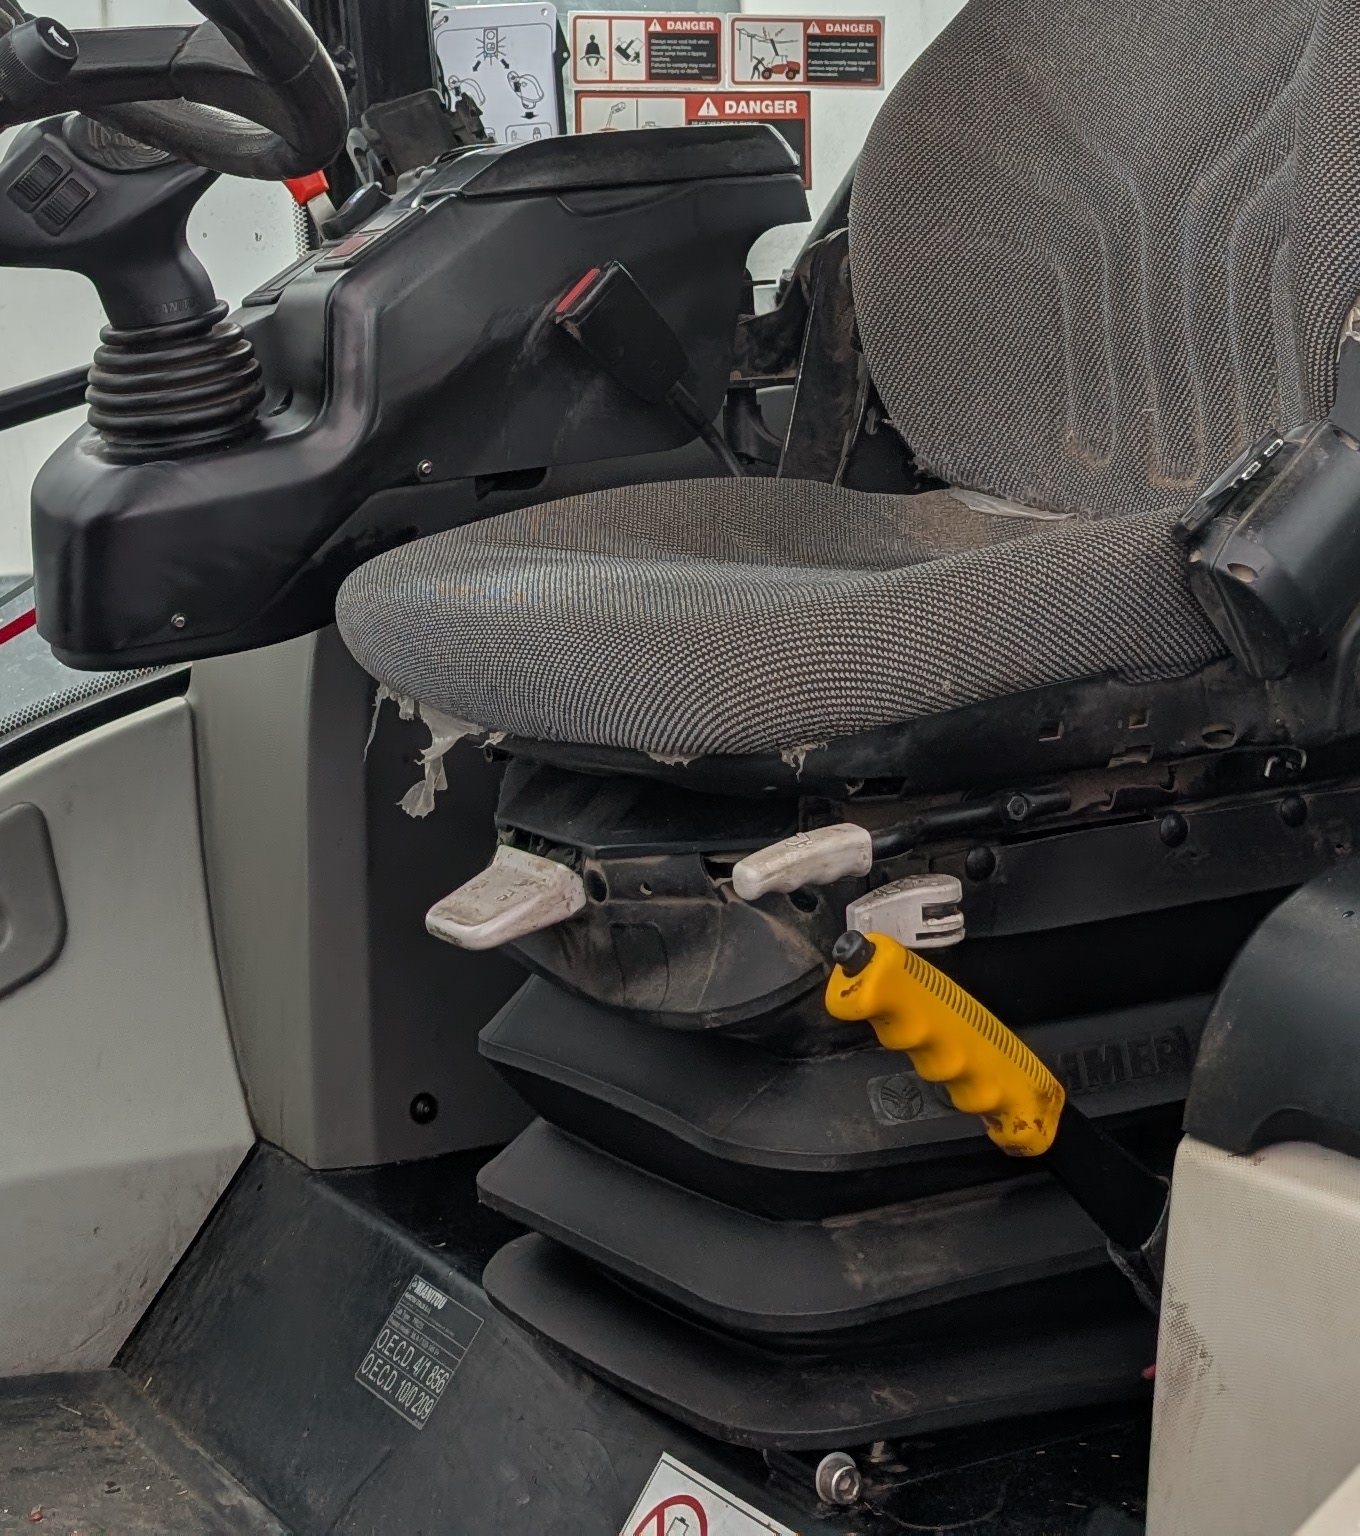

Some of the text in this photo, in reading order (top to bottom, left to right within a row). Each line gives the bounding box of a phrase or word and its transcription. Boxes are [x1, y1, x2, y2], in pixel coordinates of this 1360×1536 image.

[666, 20, 715, 31] DANGER
[825, 23, 874, 33] DANGER
[724, 100, 798, 114] DANGER
[414, 1280, 447, 1309] MANITOU
[377, 1329, 415, 1369] O.E.C.D.
[413, 1355, 431, 1380] 4/1
[426, 1366, 450, 1393] 856
[361, 1353, 434, 1419] O.E.C.D. 10/0 209
